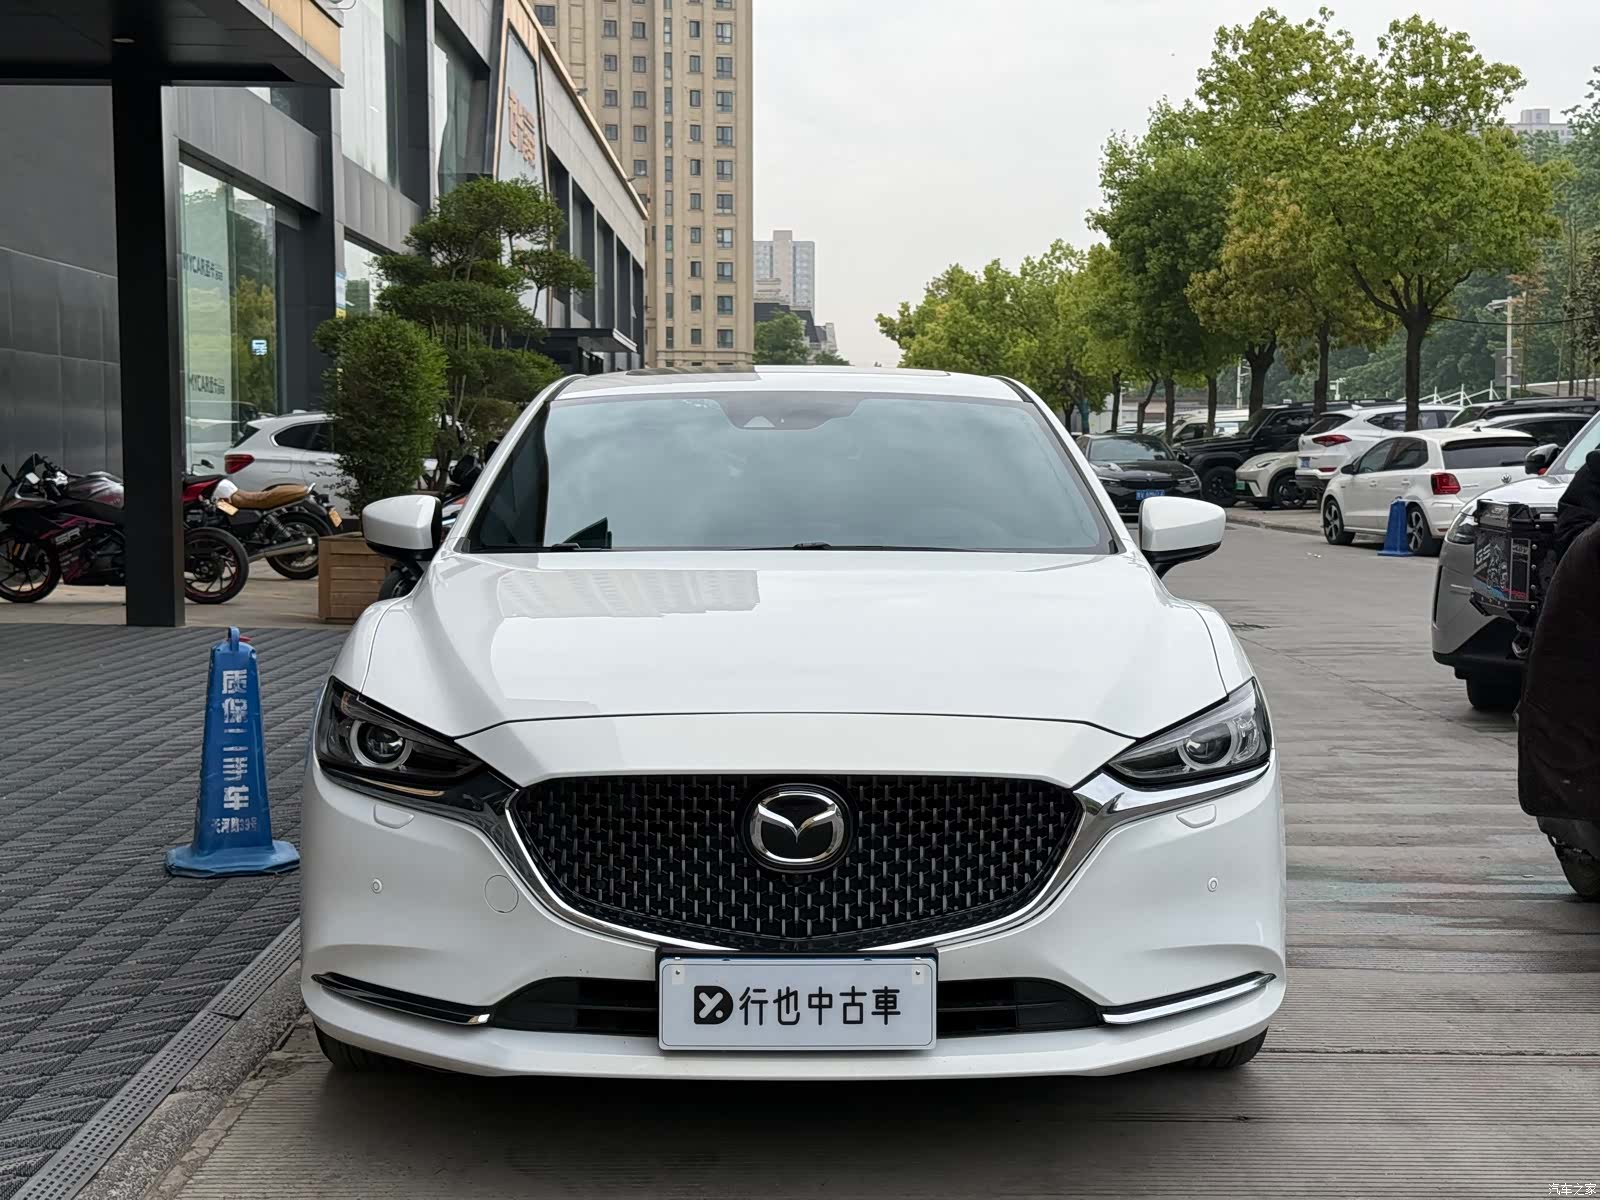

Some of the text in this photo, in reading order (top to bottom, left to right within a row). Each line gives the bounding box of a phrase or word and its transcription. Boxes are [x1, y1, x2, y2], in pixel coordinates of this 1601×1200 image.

[739, 986, 901, 1025] 行也中古車
